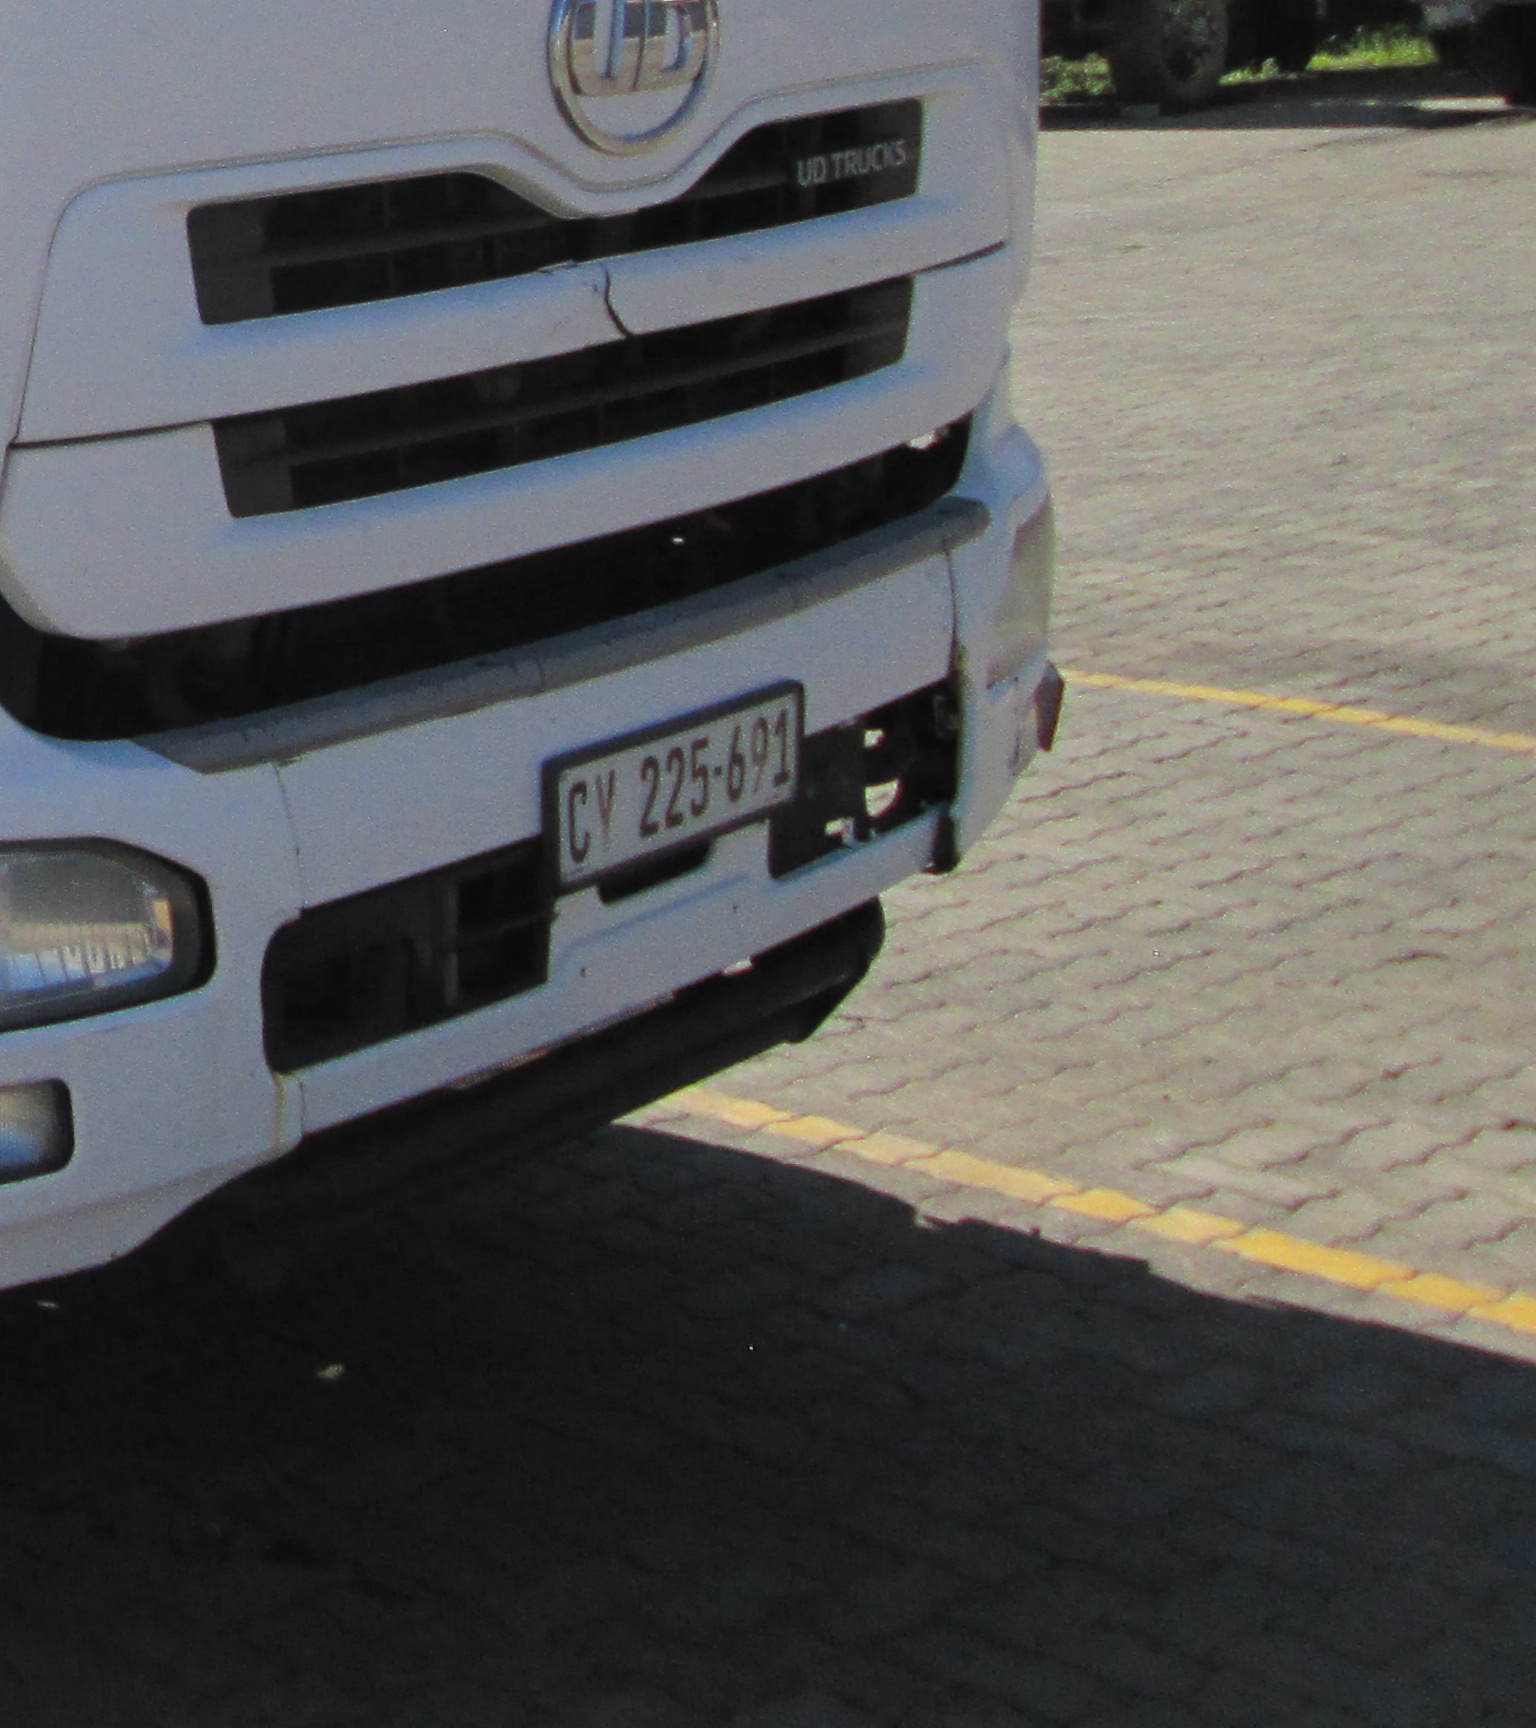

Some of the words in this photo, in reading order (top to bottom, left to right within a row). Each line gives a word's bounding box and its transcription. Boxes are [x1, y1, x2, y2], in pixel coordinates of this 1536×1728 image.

[796, 155, 826, 187] UD
[830, 138, 907, 180] TRUCKS
[568, 768, 616, 864] CY
[639, 708, 791, 839] 225-691
